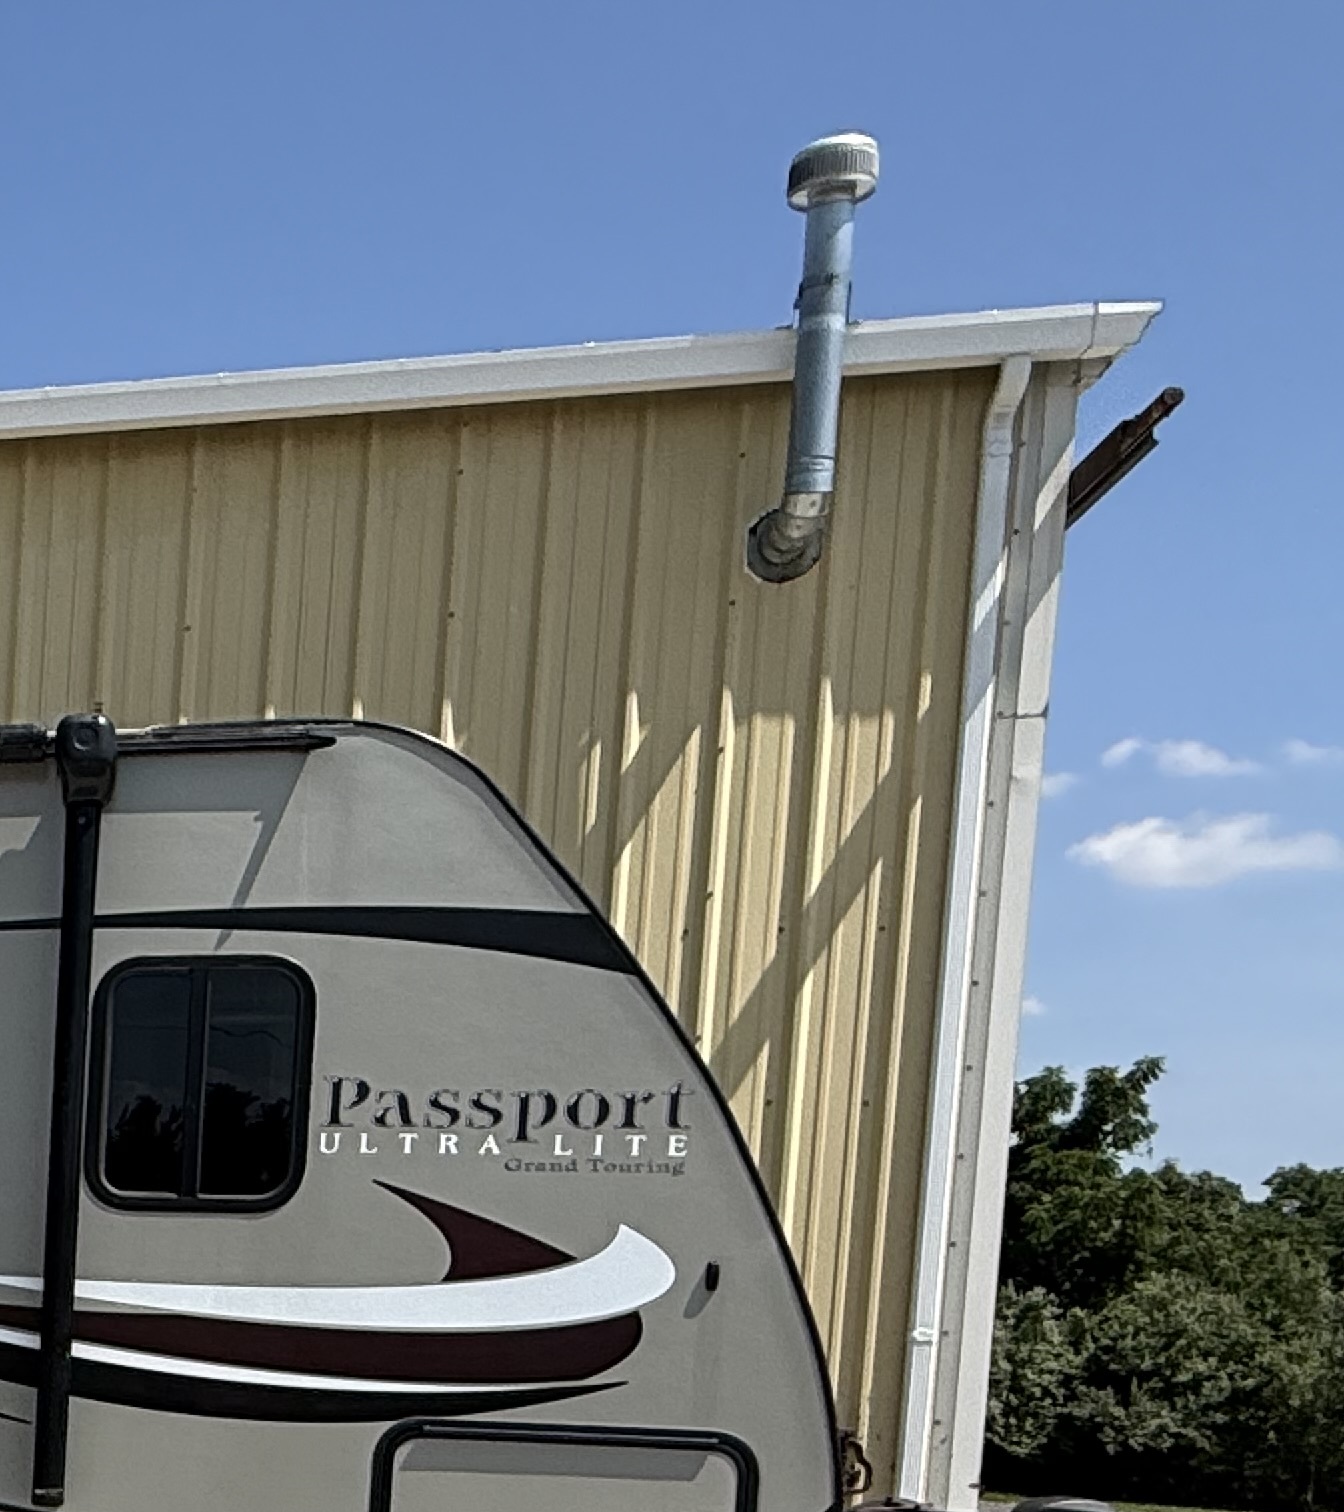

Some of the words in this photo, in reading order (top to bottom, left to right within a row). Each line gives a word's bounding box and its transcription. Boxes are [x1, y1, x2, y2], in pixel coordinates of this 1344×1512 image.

[319, 1074, 695, 1144] Passport
[319, 1132, 501, 1155] ULTRA
[553, 1133, 689, 1157] LITE
[504, 1158, 578, 1173] Grand
[586, 1158, 686, 1177] Touring
